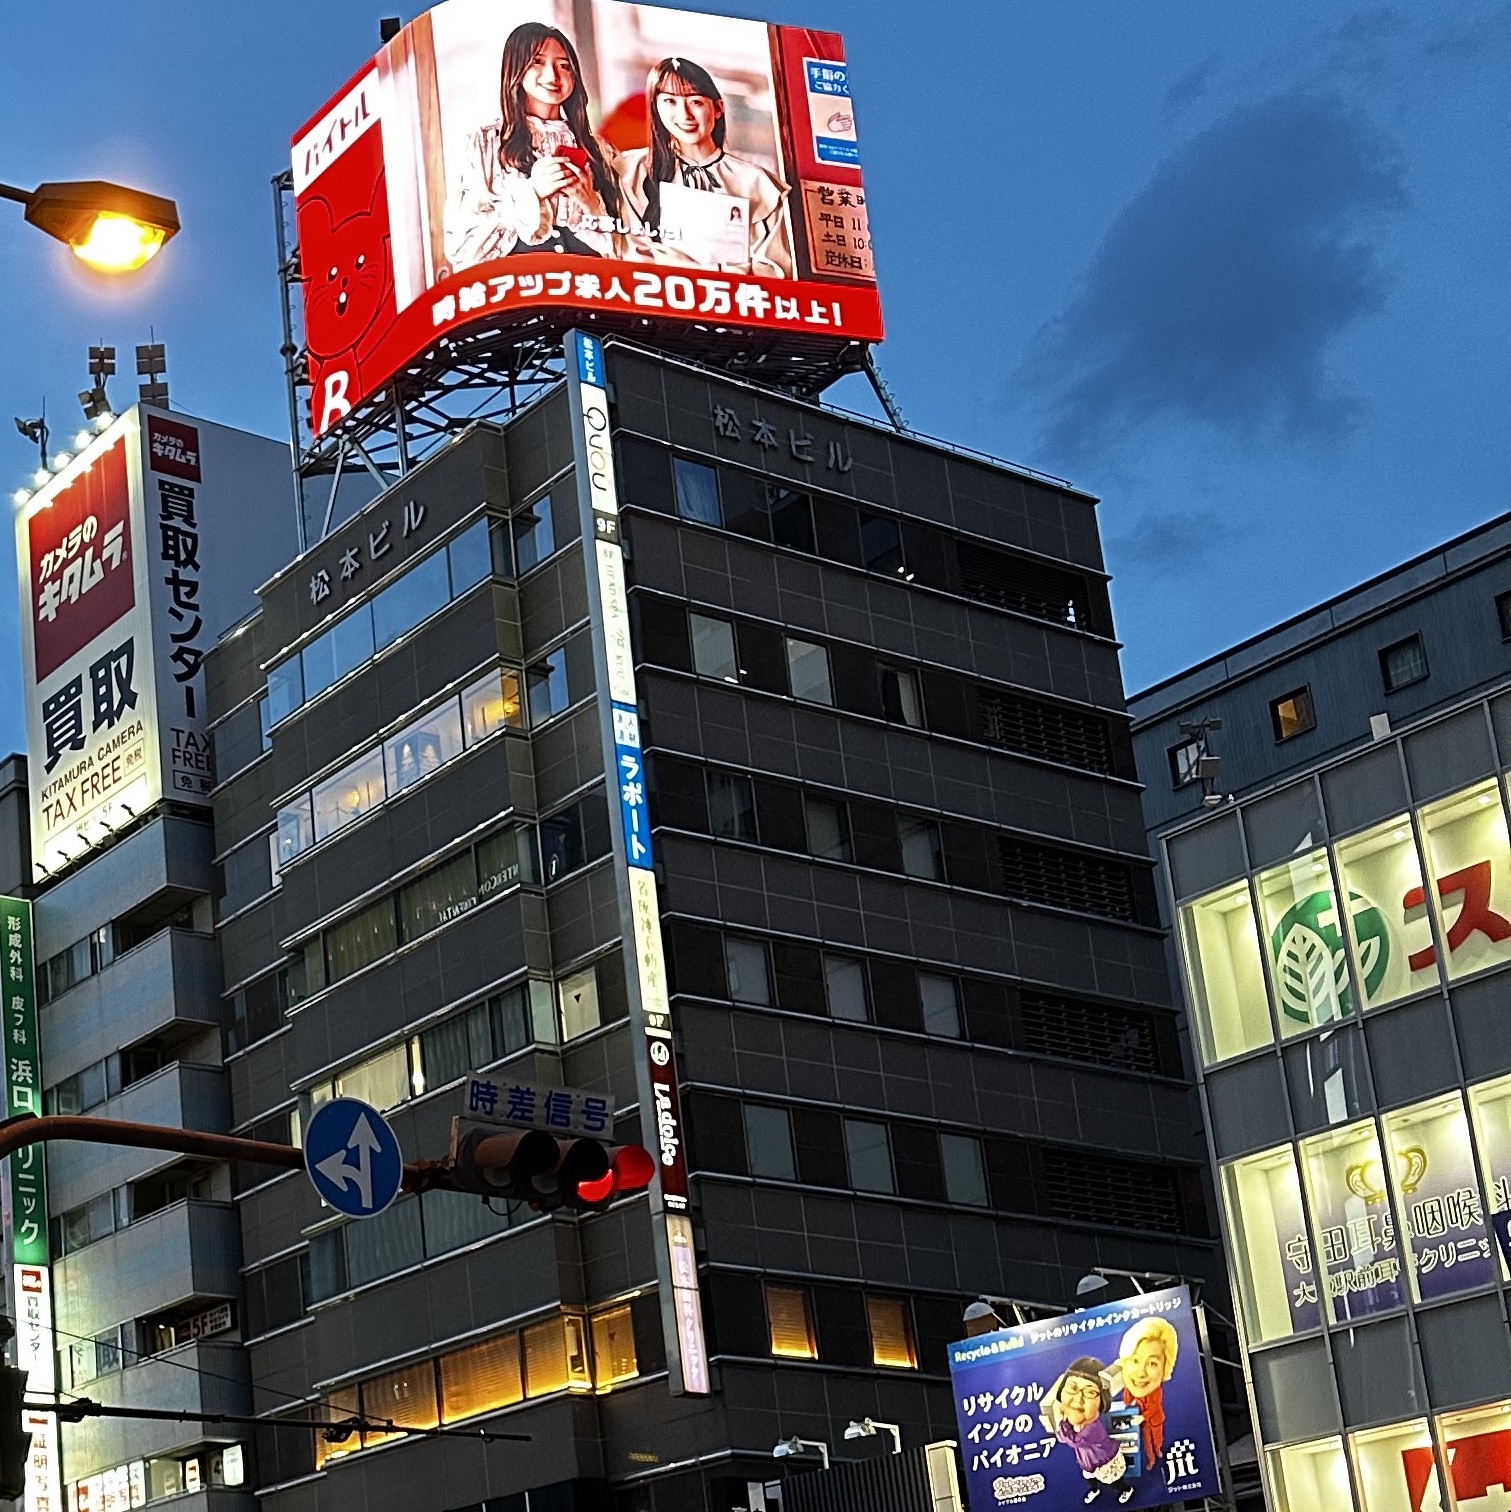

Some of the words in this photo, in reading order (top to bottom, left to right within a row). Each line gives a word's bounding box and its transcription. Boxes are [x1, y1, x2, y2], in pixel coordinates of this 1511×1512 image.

[303, 90, 371, 178] バイトル
[818, 213, 845, 229] 平日
[151, 441, 198, 467] キタムラ
[153, 431, 184, 449] カメラの
[713, 404, 853, 472] 松本ビル
[39, 515, 98, 583] カメラの
[309, 500, 425, 605] 松本ビル
[596, 517, 616, 534] 9F
[38, 519, 126, 622] キタムラ
[159, 479, 203, 718] 買取センター
[42, 635, 139, 775] 買取
[41, 756, 95, 802] KITAMURA
[97, 720, 144, 761] CAMERA
[171, 727, 210, 753] TAX
[42, 786, 78, 831] TAX
[80, 755, 122, 807] FREE
[620, 754, 646, 860] ラポート
[6, 916, 23, 982] 形成外科
[1403, 860, 1511, 972] ス
[11, 995, 27, 1045] 皮フ科
[469, 1080, 609, 1132] 時差信号
[10, 1058, 39, 1246] 浜口リニック
[963, 1382, 1044, 1416] リサイクル
[968, 1414, 1033, 1444] インクの
[972, 1437, 1057, 1471] パイオニア
[1167, 1451, 1199, 1485] jit
